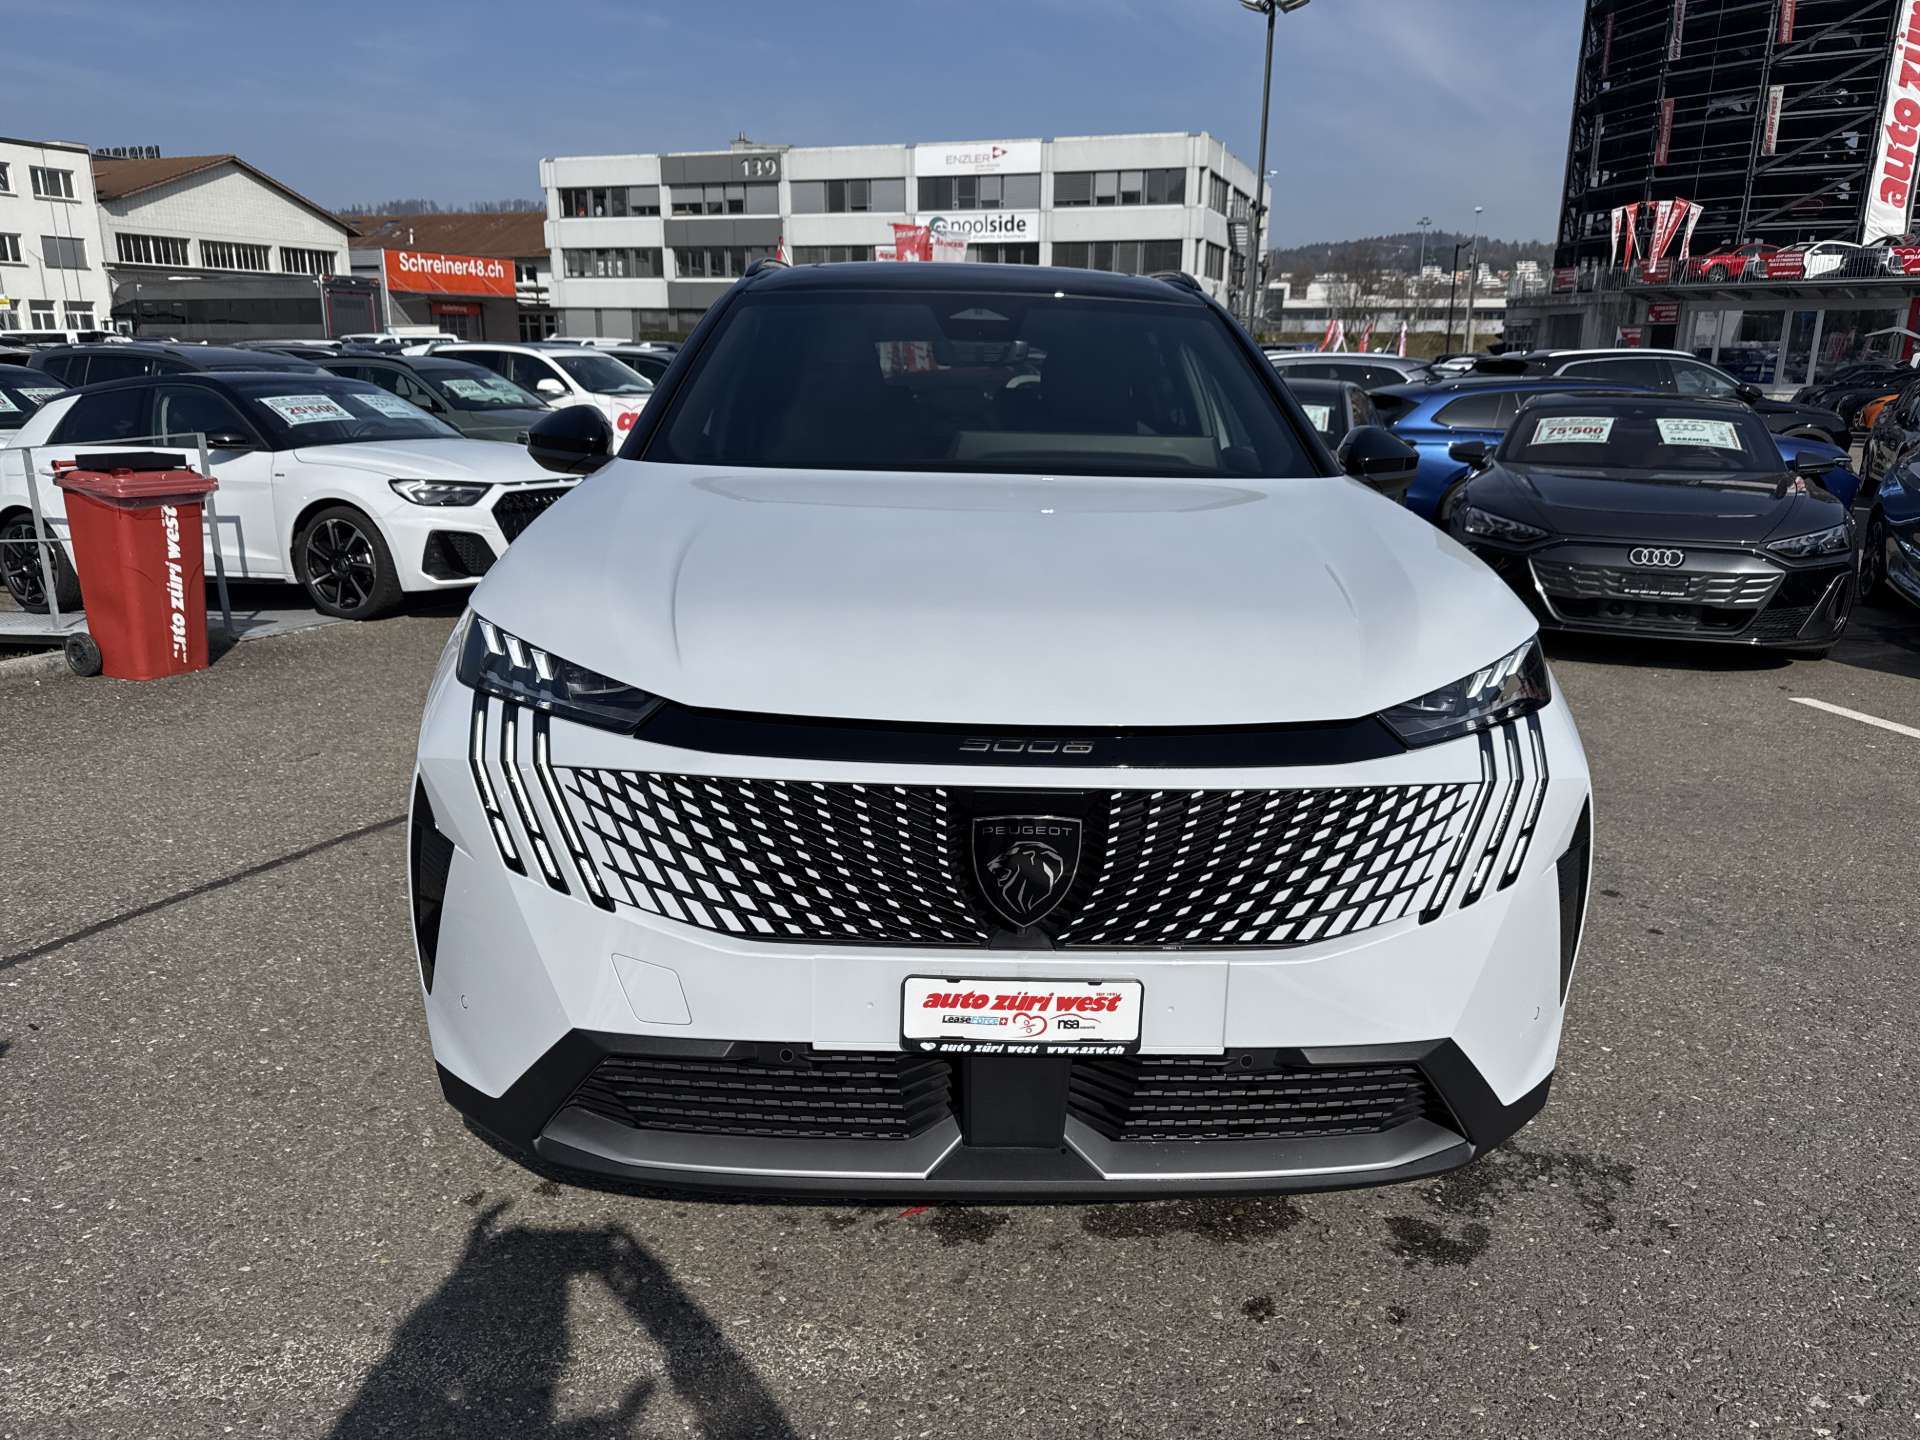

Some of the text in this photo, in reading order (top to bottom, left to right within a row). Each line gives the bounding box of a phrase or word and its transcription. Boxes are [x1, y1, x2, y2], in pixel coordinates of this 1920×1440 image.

[1879, 97, 1920, 208] auto
[945, 154, 990, 165] ENZLER
[399, 252, 504, 278] Schreiner48.ch
[1547, 426, 1604, 435] 75'500
[162, 504, 188, 663] uto züri west
[959, 738, 1095, 754] 5008
[982, 826, 1073, 837] PEUGEOT
[922, 991, 1123, 1012] auto züri west
[942, 1015, 999, 1025] LeaseForce
[1057, 1019, 1080, 1030] nsa
[940, 1042, 1125, 1055] auto züri west www.azw.ch
